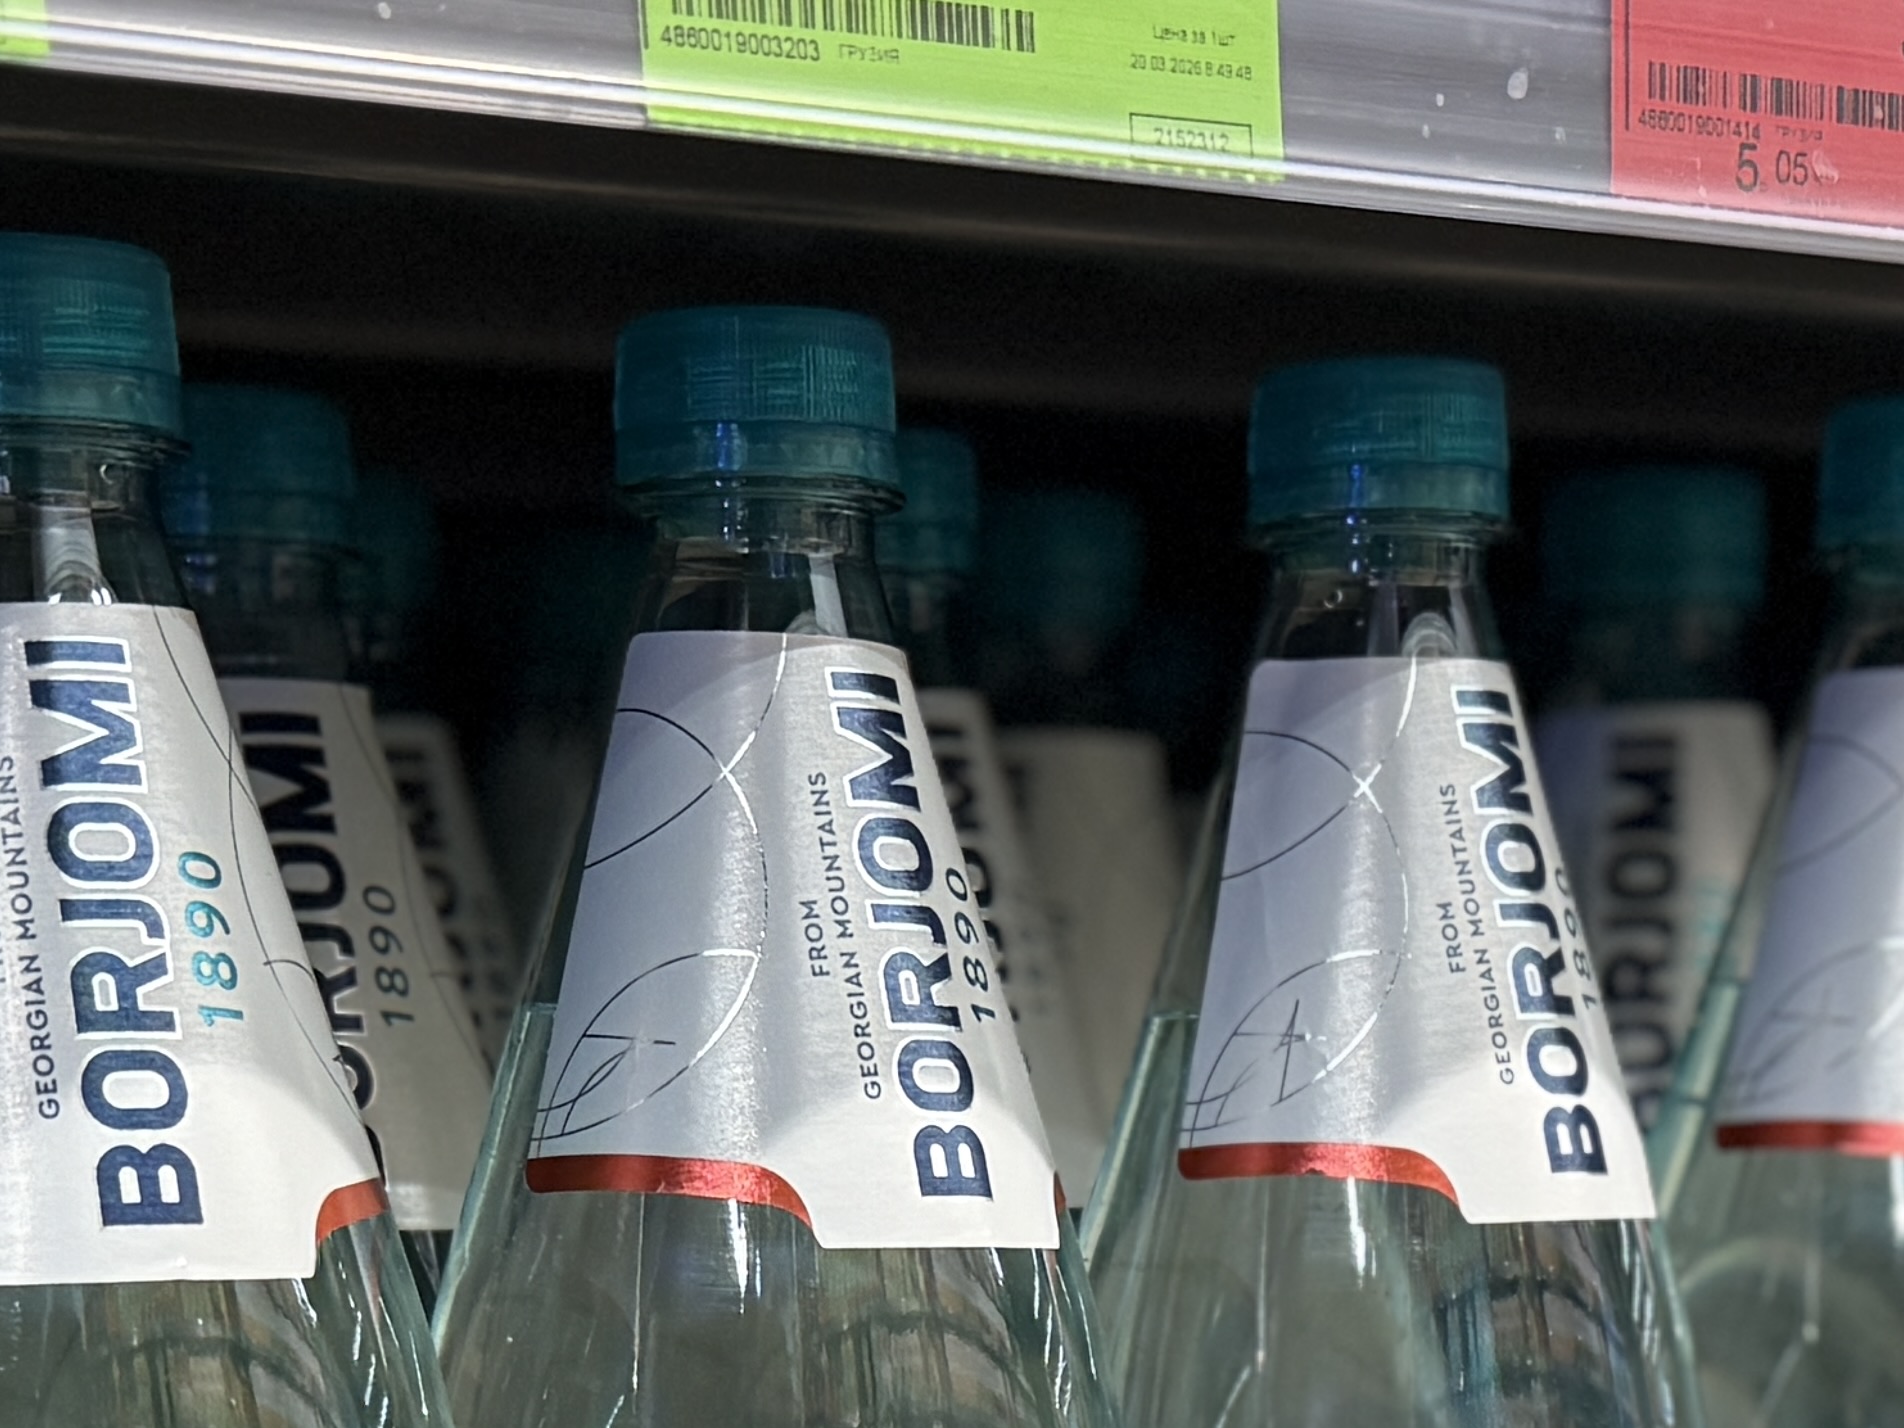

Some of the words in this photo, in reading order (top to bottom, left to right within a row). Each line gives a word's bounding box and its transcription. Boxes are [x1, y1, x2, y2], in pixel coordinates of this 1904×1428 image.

[660, 25, 822, 62] 4860019003203
[23, 635, 204, 1228] BORJOMI
[805, 771, 857, 939] MOUNTAINS
[1439, 783, 1487, 938] MOUNTAINS
[1451, 684, 1609, 1176] BORJOMI
[176, 850, 245, 1028] 1890
[362, 884, 415, 1029] 1890
[799, 899, 831, 979] FROM
[824, 666, 994, 1201] BORJOMI
[944, 867, 997, 1024] 1890
[1437, 901, 1468, 976] FROM
[21, 952, 61, 1120] GEORGIAN
[837, 950, 882, 1101] GEORGIAN
[1476, 947, 1516, 1085] GEORGIAN
